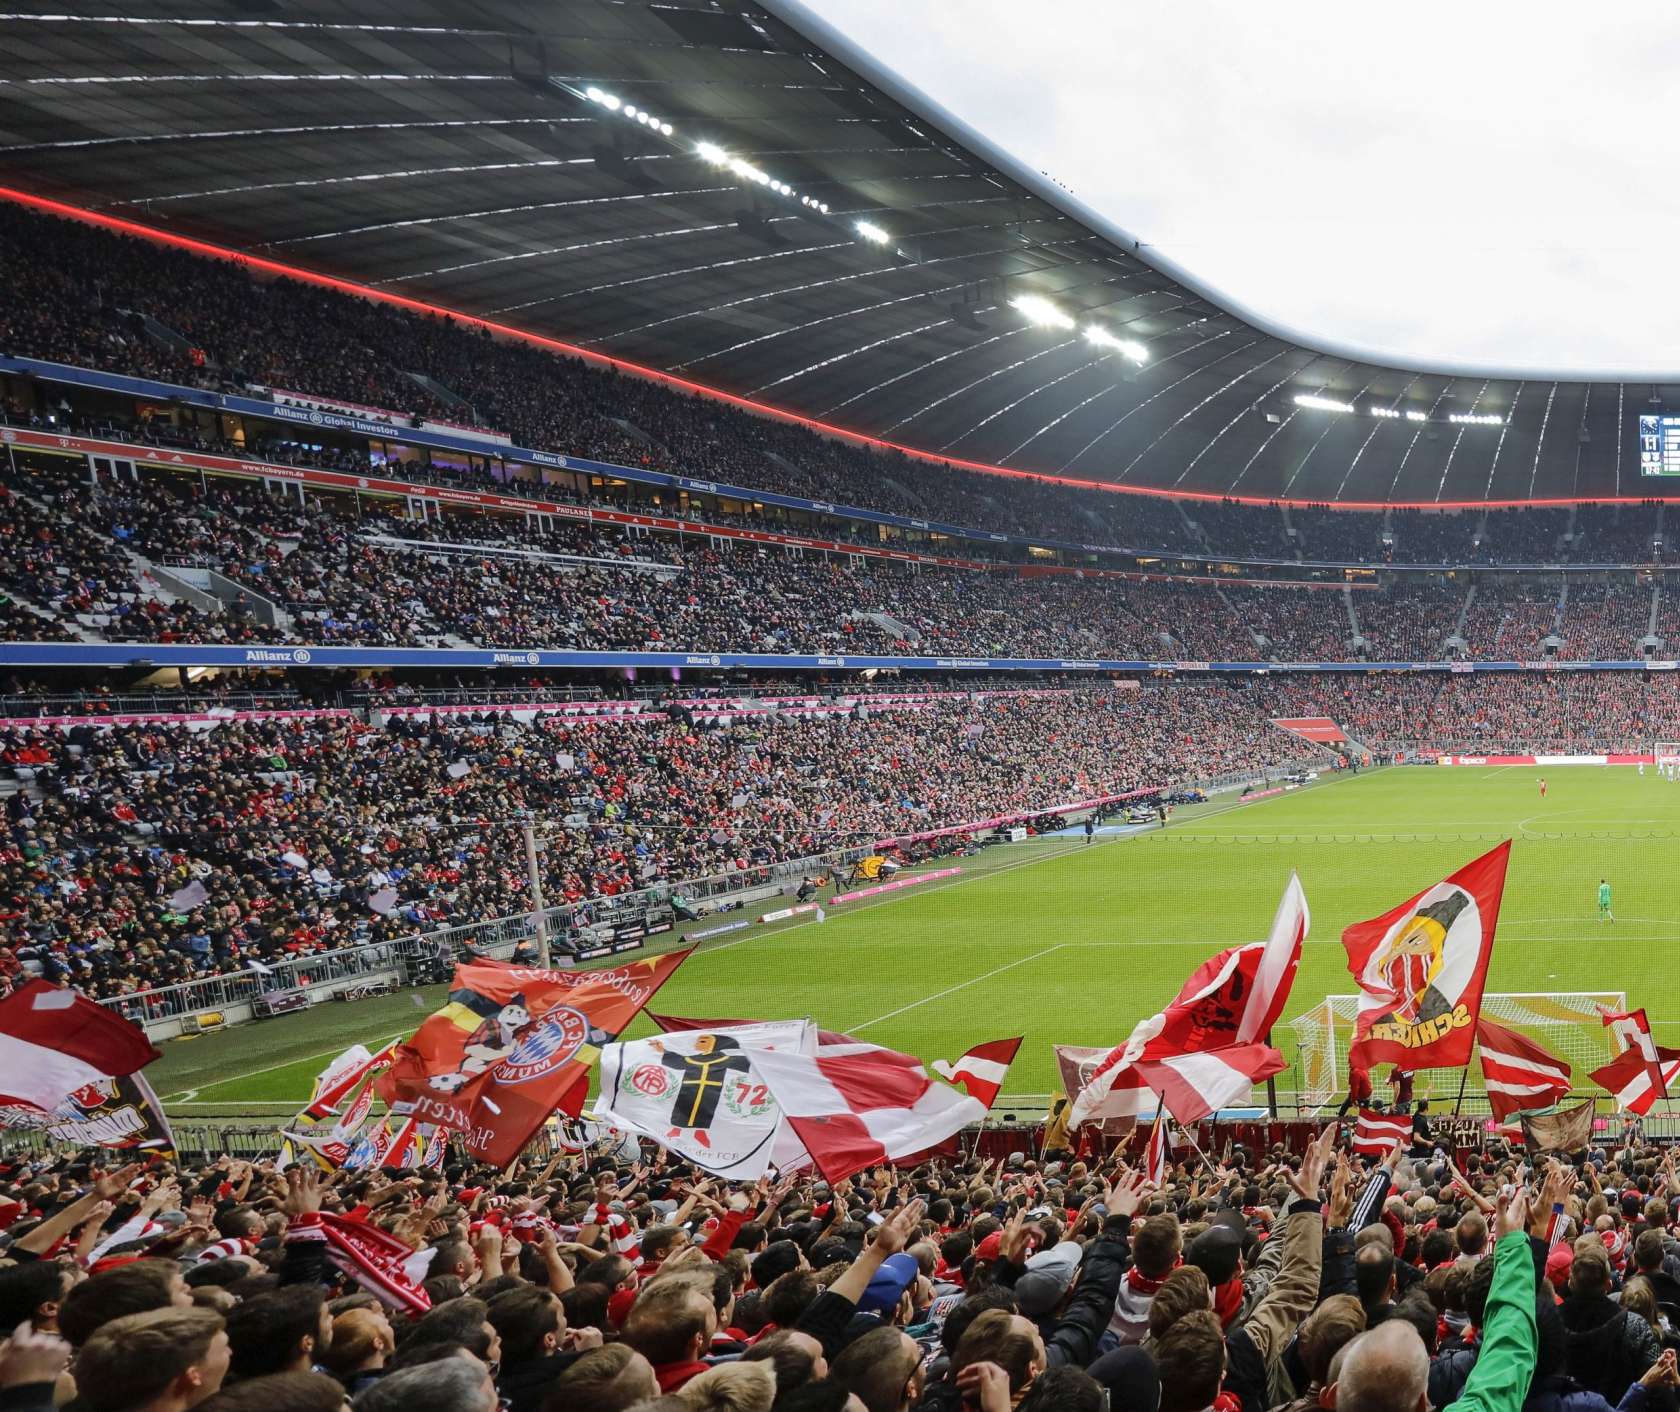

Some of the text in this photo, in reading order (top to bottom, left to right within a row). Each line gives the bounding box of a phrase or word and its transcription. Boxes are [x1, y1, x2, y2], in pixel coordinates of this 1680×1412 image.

[274, 406, 399, 436] Allianz Global Investors
[532, 452, 556, 464] Allianz
[241, 463, 305, 479] www.fcbayern.de
[246, 649, 292, 661] Allianz
[493, 653, 526, 664] Allianz
[686, 655, 710, 665] Allianz
[818, 657, 836, 665] Allianz
[735, 1082, 769, 1106] 72
